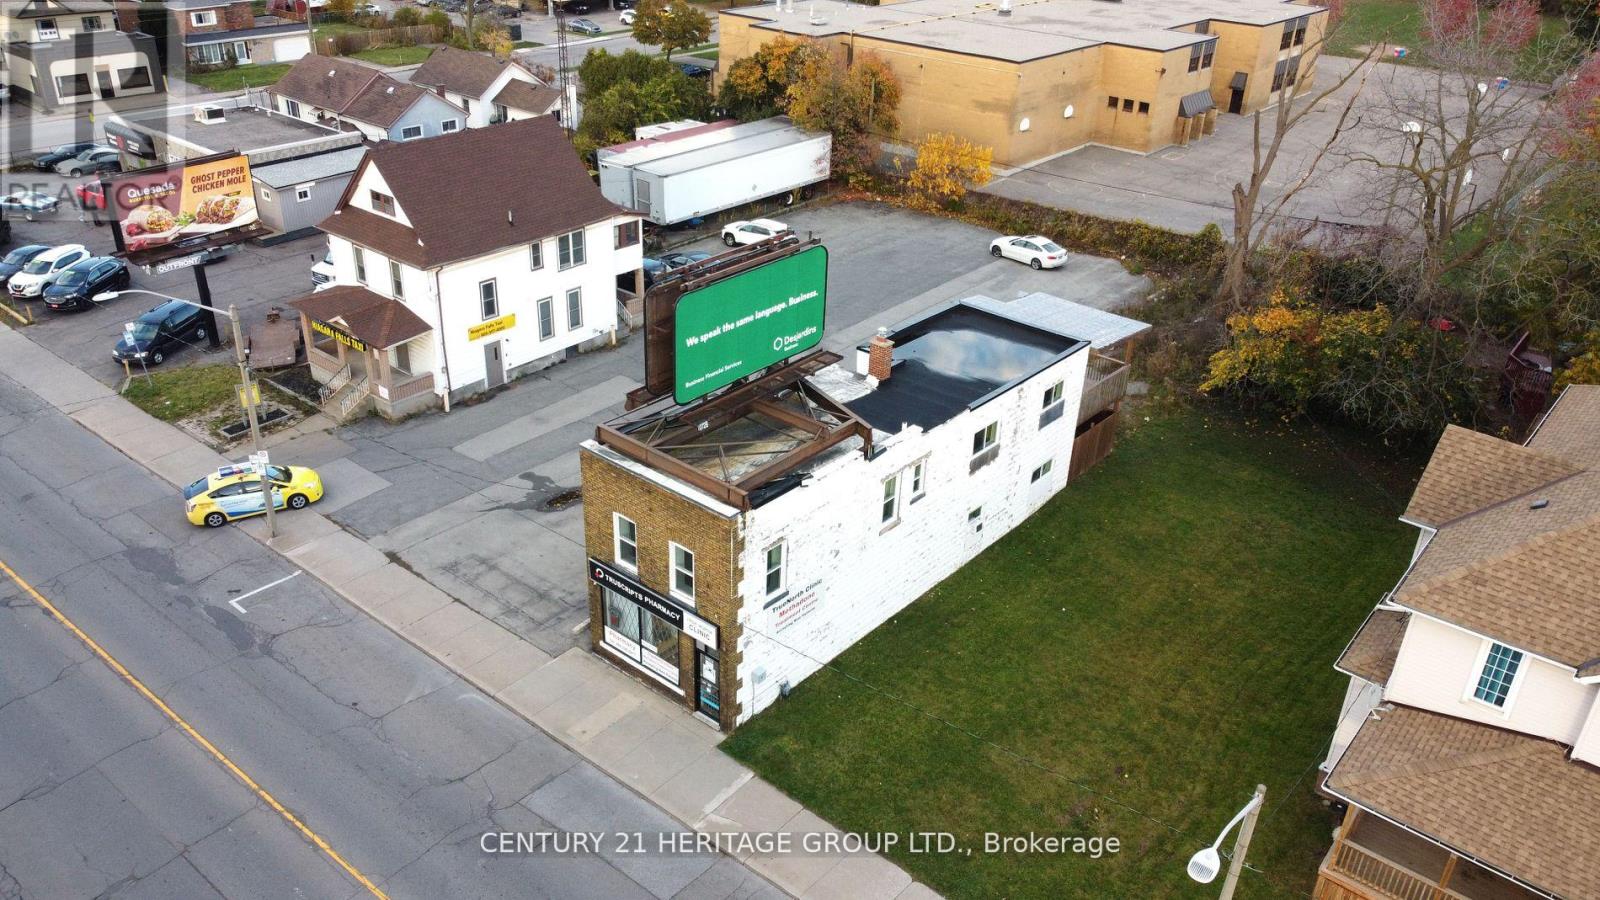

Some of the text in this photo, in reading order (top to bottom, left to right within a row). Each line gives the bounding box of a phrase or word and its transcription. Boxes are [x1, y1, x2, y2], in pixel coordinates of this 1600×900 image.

[190, 166, 245, 185] GHOST PEPPER
[192, 180, 225, 194] CHICKEN
[227, 174, 247, 187] MOLE
[127, 181, 176, 198] Quesada
[686, 290, 818, 347] We speak the same language. Business.
[311, 320, 364, 352] NIAGARA FALLS TAXI
[784, 326, 817, 345] Desjardins
[605, 574, 681, 620] TRUSCRIPTS PHARMACY
[772, 579, 823, 613] TrueNorth Clinic
[779, 592, 816, 618] Methadone
